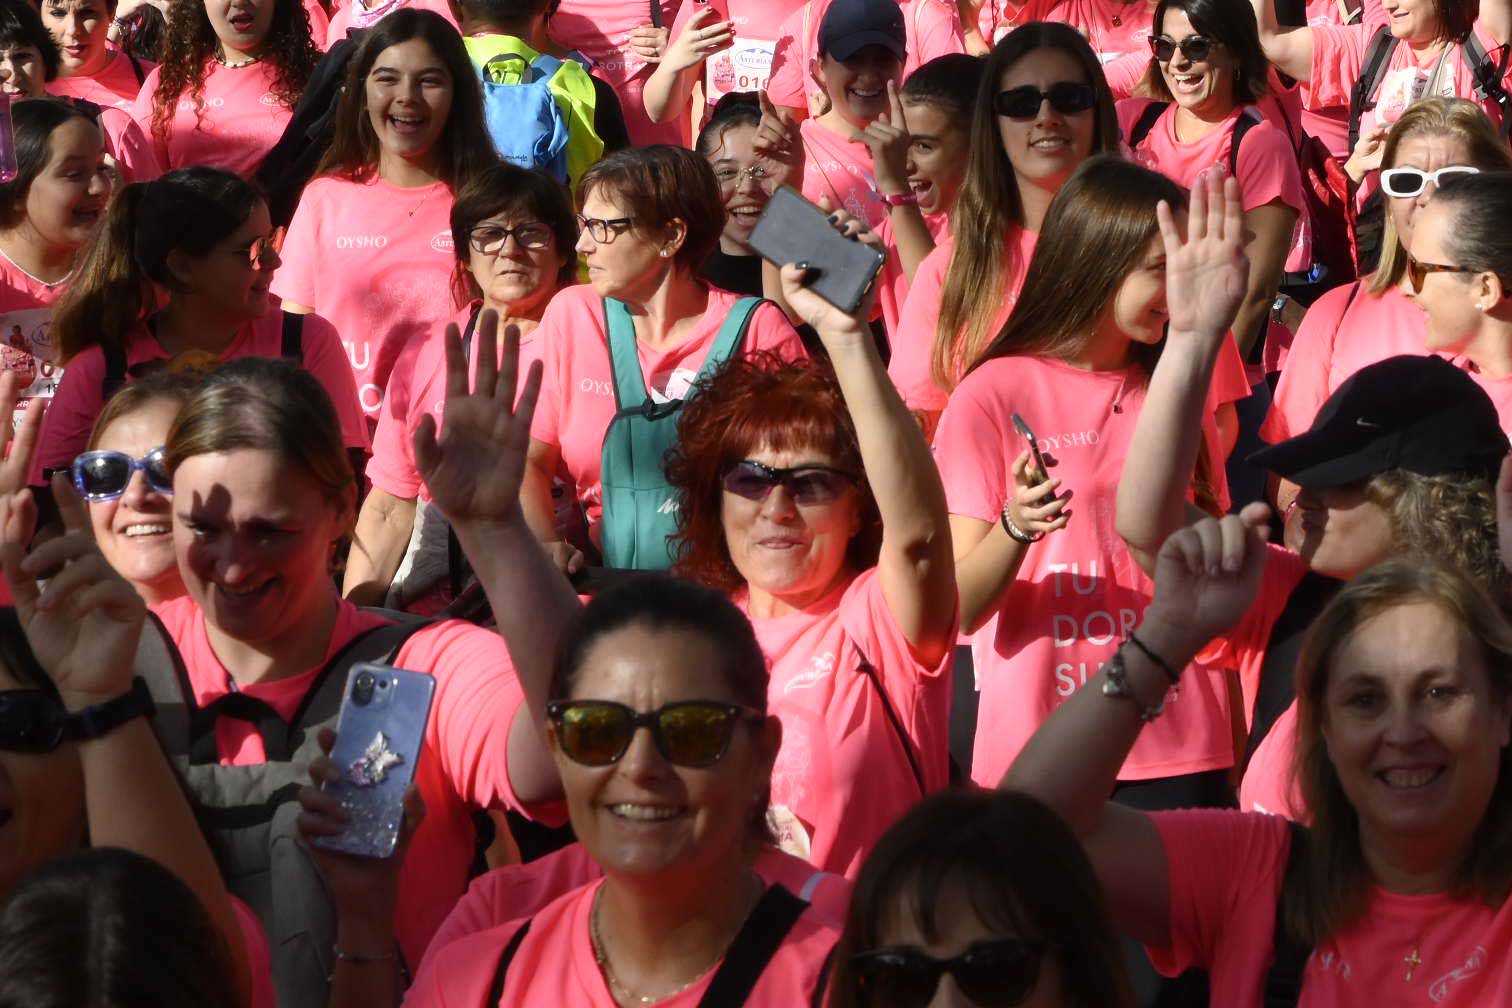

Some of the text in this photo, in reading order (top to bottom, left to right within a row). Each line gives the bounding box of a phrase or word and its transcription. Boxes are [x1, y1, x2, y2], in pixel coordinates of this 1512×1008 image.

[336, 235, 388, 250] OYSHO
[580, 378, 614, 396] OYS
[1035, 431, 1100, 452] OYSHO
[1048, 560, 1097, 597] TU
[1053, 609, 1137, 648] DOR
